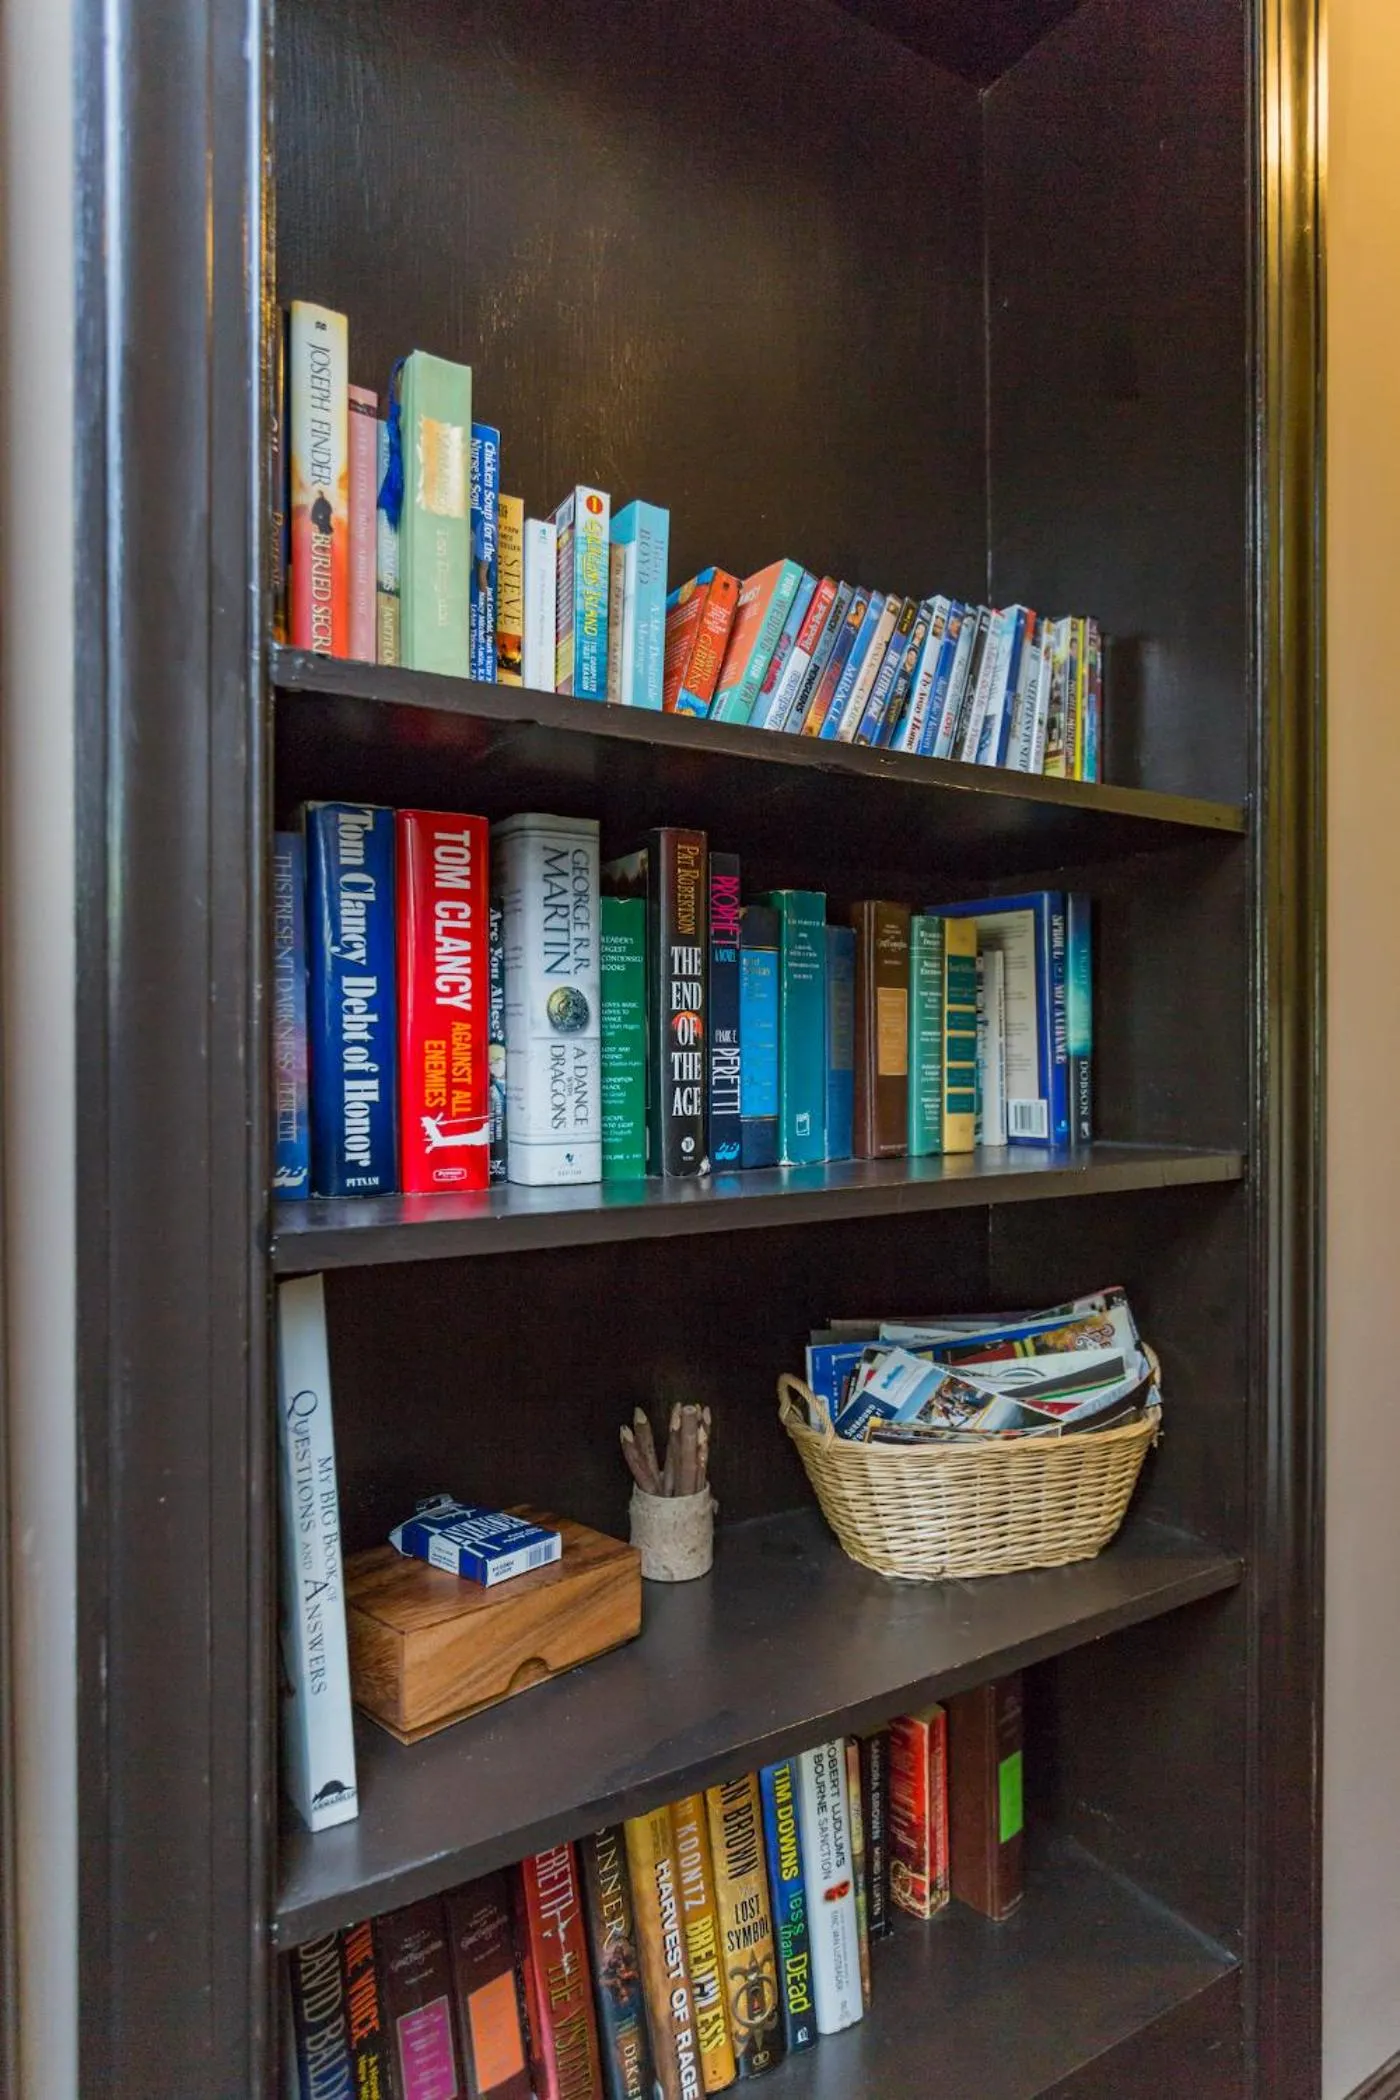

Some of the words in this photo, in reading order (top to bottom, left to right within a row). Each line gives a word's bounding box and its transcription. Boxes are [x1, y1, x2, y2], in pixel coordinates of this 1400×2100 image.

[307, 341, 332, 414] JOSEPH
[310, 418, 332, 487] FINDER
[471, 438, 483, 481] Nurse's
[484, 441, 496, 489] Chicken
[471, 482, 483, 511] Soul
[482, 490, 496, 520] Soup
[482, 522, 494, 541] for
[483, 542, 495, 562] the
[638, 528, 652, 585] BOYD
[311, 532, 333, 602] BURIED
[503, 556, 521, 628] STEVE
[584, 589, 602, 637] ISLAND
[762, 599, 785, 648] WEDDING
[684, 633, 712, 694] GIBBINS
[795, 663, 820, 713] PENGUINS
[827, 662, 857, 722] MIRACLE
[905, 715, 922, 751] Home
[337, 809, 375, 865] Tom
[434, 829, 471, 889] TOM
[677, 844, 700, 867] PAT
[273, 852, 293, 893] THIS
[571, 848, 590, 931] GEORGE
[677, 868, 701, 936] ROBERTSON
[274, 895, 294, 974] PRESENT
[331, 872, 377, 966] Clancy
[542, 845, 571, 976] MARTIN
[711, 875, 740, 949] PROPHET
[1051, 914, 1065, 960] SPROUL
[435, 900, 472, 1011] CLANCY
[670, 946, 701, 976] THE
[276, 978, 298, 1070] DARKNESS
[341, 975, 378, 1042] Debt
[670, 980, 702, 1010] END
[342, 1046, 379, 1073] of
[452, 1021, 472, 1086] AGAINST
[572, 1046, 588, 1060] A
[676, 1016, 698, 1046] OF
[424, 1039, 446, 1107] ENEMIES
[550, 1044, 567, 1130] DRAGONS
[574, 1065, 589, 1127] DANCE
[670, 1051, 701, 1081] THE
[711, 1047, 740, 1115] PERETTI
[1079, 1060, 1089, 1116] DOBSON
[277, 1081, 298, 1144] PERETTI
[344, 1079, 380, 1167] Honor
[451, 1089, 471, 1116] ALL
[671, 1087, 702, 1117] AGE
[286, 1389, 319, 1534] QUESTIONS
[318, 1490, 337, 1527] BIG
[301, 1541, 313, 1571] AND
[302, 1578, 330, 1697] ANSWERS
[771, 1764, 792, 1799] TIM
[812, 1753, 828, 1817] BOURNE
[870, 1739, 880, 1791] SANDRA
[723, 1807, 758, 1881] BROWN
[775, 1800, 800, 1882] DOWNS
[831, 1800, 846, 1869] LUDLUM'S
[871, 1792, 881, 1840] BROWN
[676, 1824, 705, 1911] KOONTZ
[817, 1818, 833, 1882] SANCTION
[655, 1858, 685, 1981] HARVEST
[727, 1919, 772, 1954] SYMBOL
[735, 1893, 761, 1924] LOST
[787, 1886, 807, 1937] less
[344, 1917, 374, 1977] THE
[780, 1924, 793, 1960] than
[299, 1929, 342, 2022] DAVID
[548, 1950, 584, 2011] THE
[670, 1987, 690, 2024] OF
[686, 1915, 727, 2055] BREATHLESS
[786, 1952, 812, 2017] DEad
[349, 1966, 380, 2050] VOICE
[675, 2028, 699, 2100] RAGE
